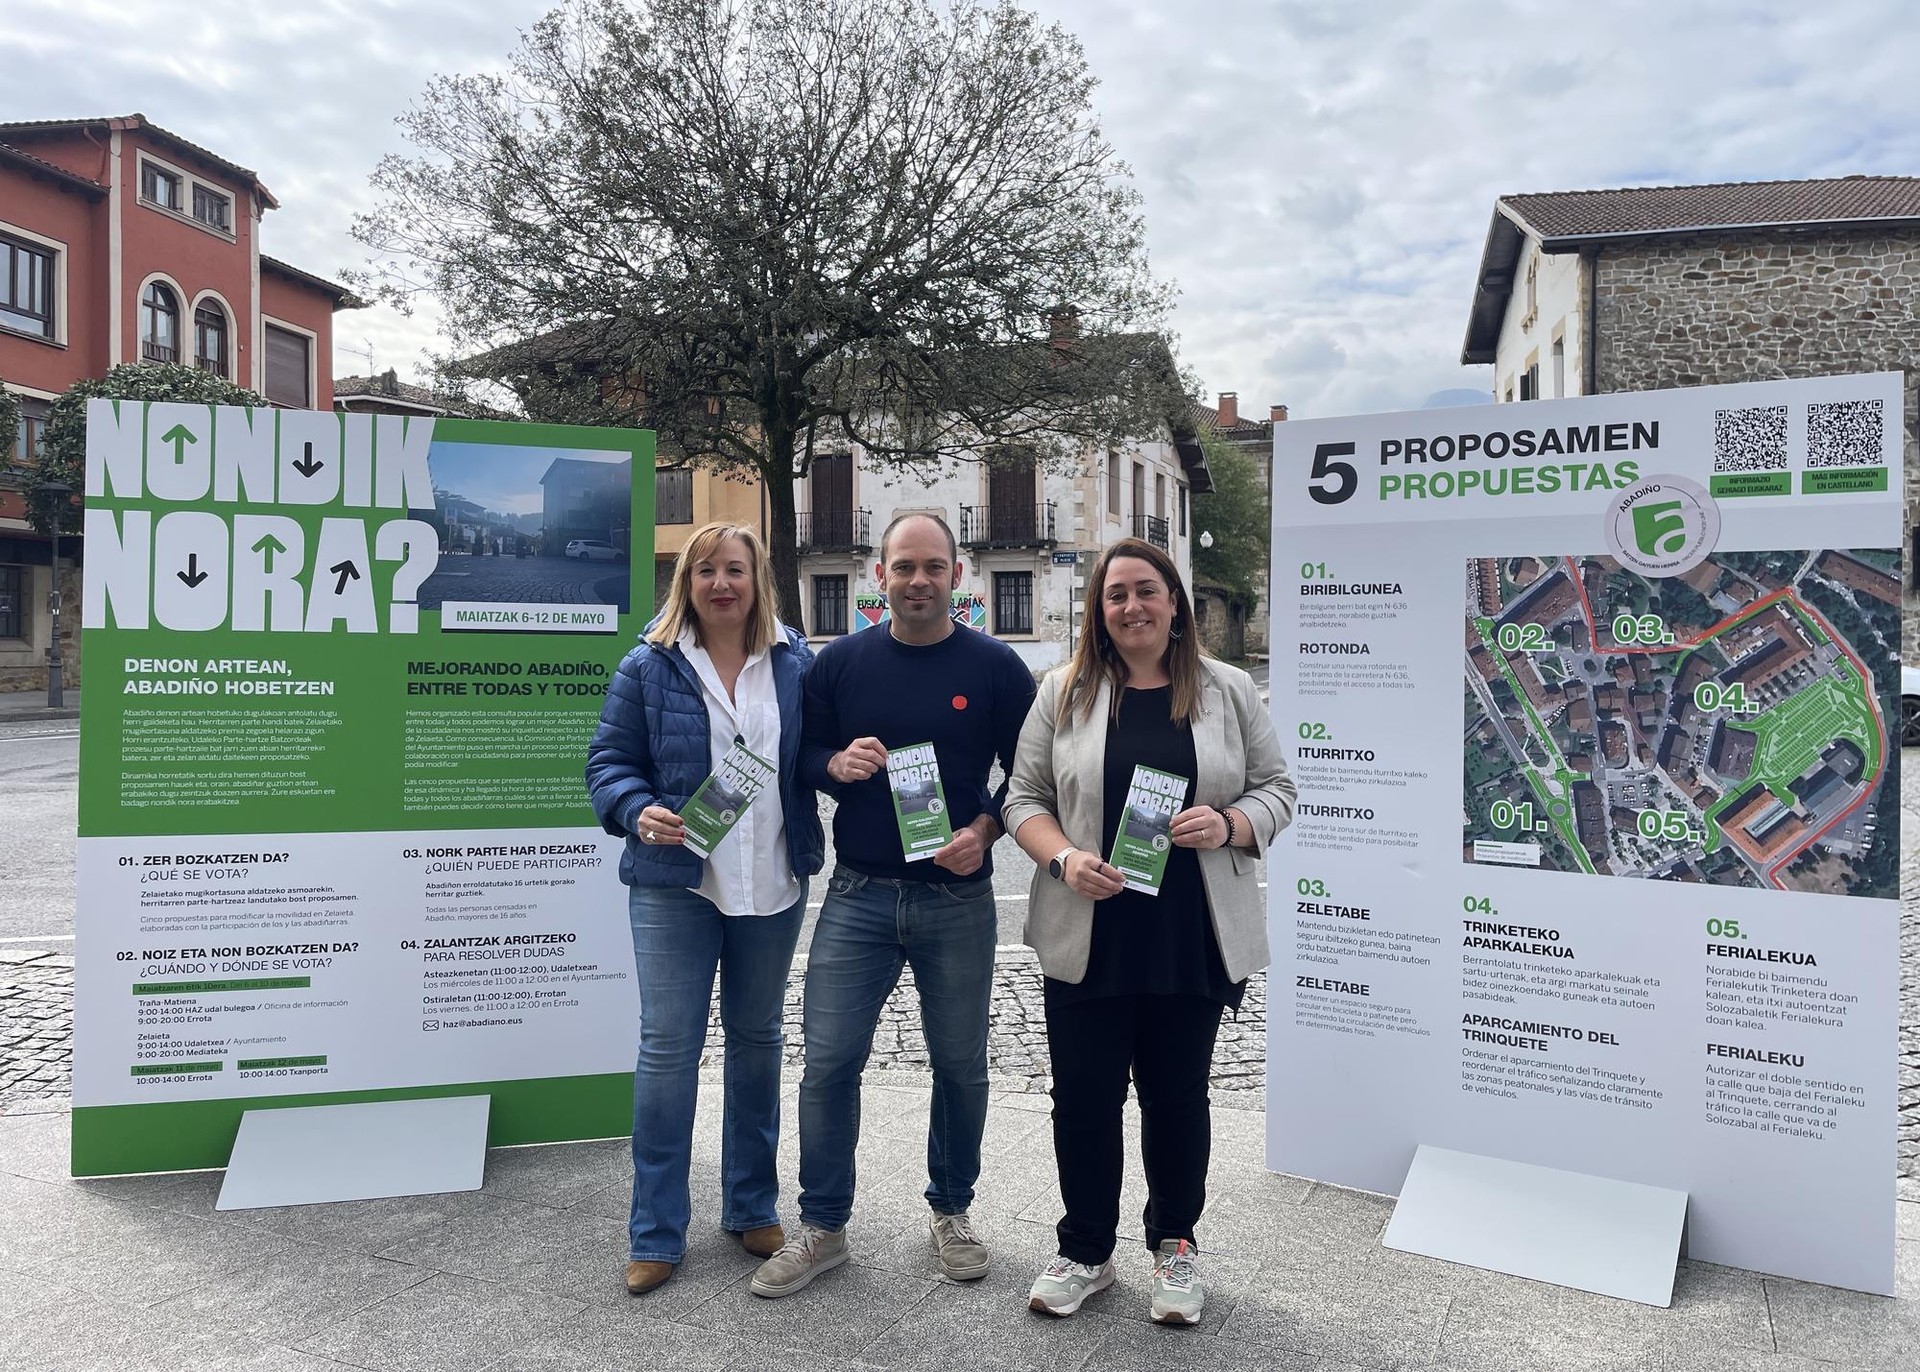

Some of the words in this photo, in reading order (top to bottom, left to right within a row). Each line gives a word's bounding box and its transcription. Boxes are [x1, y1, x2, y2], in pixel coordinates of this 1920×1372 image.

[1380, 421, 1660, 466] PROPOSAMEN
[84, 398, 436, 511] NONDIK
[1308, 442, 1358, 504] 5
[1728, 476, 1772, 486] INFORMAZIO
[1811, 472, 1828, 480] MÁS
[1829, 470, 1878, 480] INFORMACIÓN
[1379, 462, 1640, 502] PROPUESTAS
[1816, 482, 1827, 491] EN
[1828, 480, 1874, 490] CASTELLANO
[1619, 484, 1660, 512] ABADIÑO
[82, 508, 439, 634] NORA?
[1301, 562, 1334, 579] 01.
[1300, 583, 1402, 595] BIRIBILGUNEA
[456, 611, 518, 622] MAIATZAK
[521, 612, 548, 623] 6-12
[552, 612, 567, 624] DE
[571, 613, 604, 624] MAYO
[1498, 623, 1556, 651] 02.
[1612, 615, 1674, 643] 03.
[1299, 643, 1370, 654] ROTONDA
[124, 659, 198, 673] DENON
[203, 660, 292, 676] ARTEAN,
[407, 662, 522, 675] MEJORANDO
[526, 661, 609, 678] ABADIÑO,
[123, 678, 218, 694] ABADIÑO
[225, 681, 334, 695] HOBETZEN
[407, 682, 467, 695] ENTRE
[472, 682, 533, 696] TODAS
[536, 683, 549, 696] Y
[552, 683, 610, 696] TODOS
[1694, 682, 1760, 713] 04.
[1298, 722, 1332, 740] 02.
[1298, 747, 1375, 761] ITURRITXO
[1298, 804, 1374, 820] ITURRITXO
[1490, 800, 1548, 830] 01.
[1638, 810, 1700, 841] 05.
[118, 856, 138, 866] 01.
[142, 856, 171, 866] ZER
[175, 854, 258, 865] BOZKATZEN
[262, 853, 289, 863] DA?
[402, 849, 422, 858] 03.
[426, 848, 463, 858] NORK
[466, 847, 507, 856] PARTE
[510, 846, 536, 855] HAR
[540, 844, 596, 854] DEZAKE?
[424, 861, 473, 875] ¿QUIÉN
[477, 860, 520, 870] PUEDE
[523, 858, 602, 869] PARTICIPAR?
[140, 868, 178, 884] ¿QUÉ
[182, 869, 201, 880] SE
[205, 868, 248, 879] VOTA?
[550, 878, 575, 886] gorako
[184, 889, 245, 898] mugikortasuna
[1297, 878, 1331, 898] 03.
[186, 898, 246, 907] parte-hartzeaz
[1296, 902, 1370, 920] ZELETABE
[1463, 896, 1498, 915] 04.
[1462, 920, 1560, 941] TRINKETEKO
[1706, 918, 1747, 939] 05.
[400, 940, 420, 950] 04.
[423, 936, 500, 949] ZALANTZAK
[503, 933, 576, 945] ARGITZEKO
[1462, 937, 1574, 959] APARKALEKUA
[116, 951, 137, 961] 02.
[142, 949, 176, 960] NOIZ
[180, 948, 207, 959] ETA
[211, 947, 241, 957] NON
[246, 944, 328, 956] BOZKATZEN
[332, 942, 359, 952] DA?
[423, 952, 455, 962] PARA
[458, 948, 520, 960] RESOLVER
[523, 947, 565, 958] DUDAS
[1706, 944, 1817, 966] FERIALEKUA
[139, 963, 206, 978] ¿CUÁNDO
[209, 962, 218, 972] Y
[222, 960, 269, 972] DÓNDE
[272, 959, 289, 970] SE
[292, 957, 332, 969] VOTA?
[423, 969, 488, 978] Asteazkenetan
[550, 964, 597, 972] Udaletxean
[1462, 955, 1521, 970] Berrantolatu
[1523, 963, 1572, 976] trinketeko
[1574, 970, 1641, 984] aparkalekuak
[1643, 977, 1660, 987] eta
[1706, 966, 1756, 979] Norabide
[1758, 971, 1768, 980] bi
[1771, 972, 1827, 987] baimendu
[1296, 976, 1369, 996] ZELETABE
[1530, 975, 1546, 985] eta
[1548, 978, 1567, 989] argi
[1569, 981, 1611, 993] markatu
[1613, 987, 1649, 997] seinale
[1706, 978, 1768, 992] Ferialekutik
[1770, 984, 1826, 1000] Trinketera
[1829, 992, 1858, 1003] doan
[422, 995, 472, 1004] Ostiraletan
[137, 1007, 183, 1016] 9:00-14:00
[137, 1016, 185, 1025] 9:00-20:00
[442, 1018, 523, 1028] haz@abadiano.eus
[1462, 1014, 1583, 1040] APARCAMIENTO
[1588, 1031, 1619, 1046] DEL
[137, 1040, 182, 1050] 9:00-14:00
[233, 1036, 286, 1045] Ayuntamiento
[1462, 1029, 1548, 1051] TRINQUETE
[136, 1050, 184, 1059] 9:00-20:00
[1707, 1044, 1804, 1067] FERIALEKU
[136, 1076, 186, 1085] 10:00-14:00
[240, 1069, 288, 1078] 10:00-14:00
[289, 1067, 328, 1076] Txanporta
